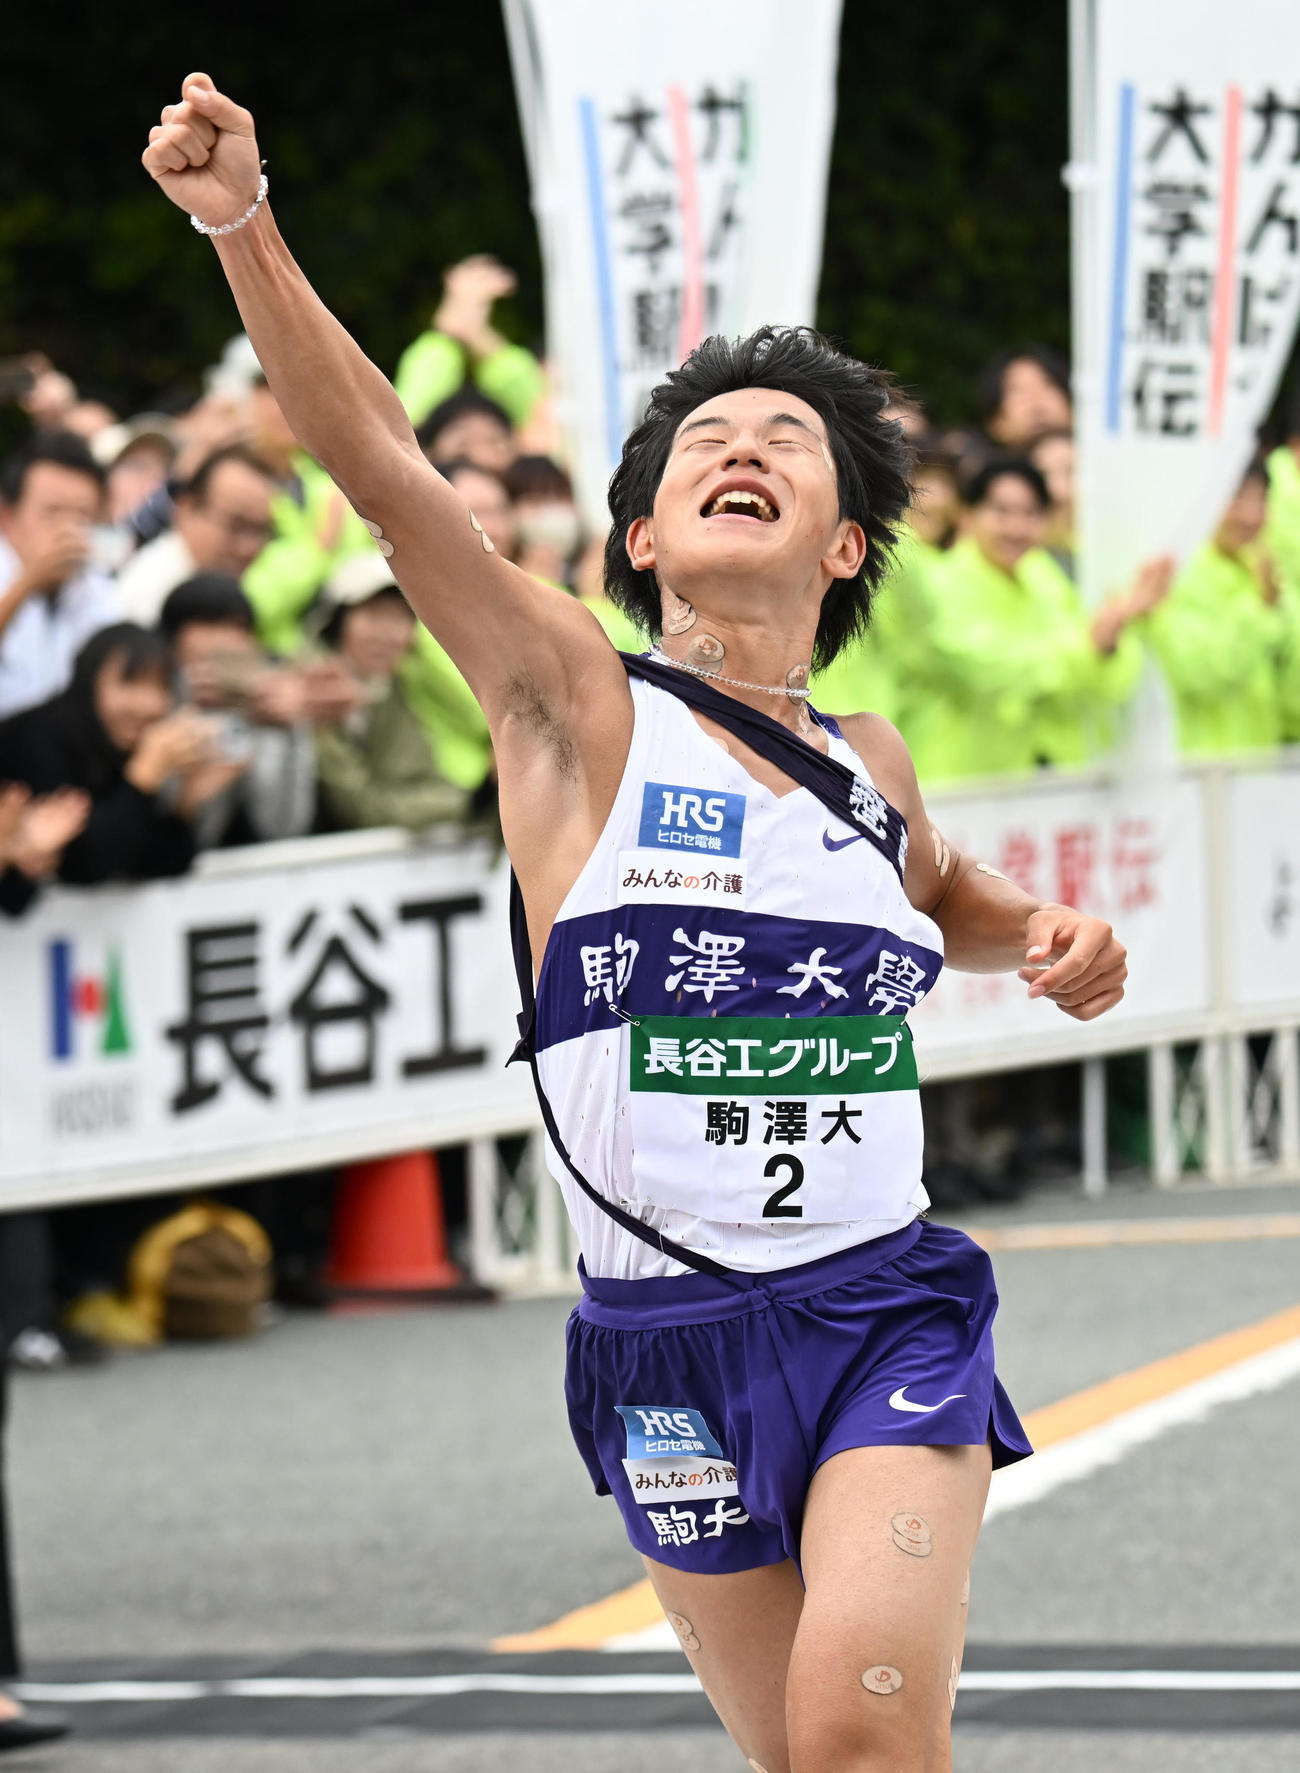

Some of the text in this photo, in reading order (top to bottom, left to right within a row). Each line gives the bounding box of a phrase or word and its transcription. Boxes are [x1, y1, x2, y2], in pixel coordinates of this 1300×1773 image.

[1133, 87, 1212, 437] 大学駅伝
[660, 791, 726, 832] HRS
[657, 829, 722, 850] ヒロセ電機
[623, 868, 743, 895] みんなの介護
[165, 892, 488, 1120] 長谷工
[643, 1032, 903, 1078] 長谷工グループ
[705, 1100, 863, 1146] 駒澤大
[763, 1153, 804, 1218] 2
[635, 1410, 697, 1437] HRS
[646, 1439, 706, 1453] ヒロセ電機
[646, 1499, 750, 1547] 駒大
